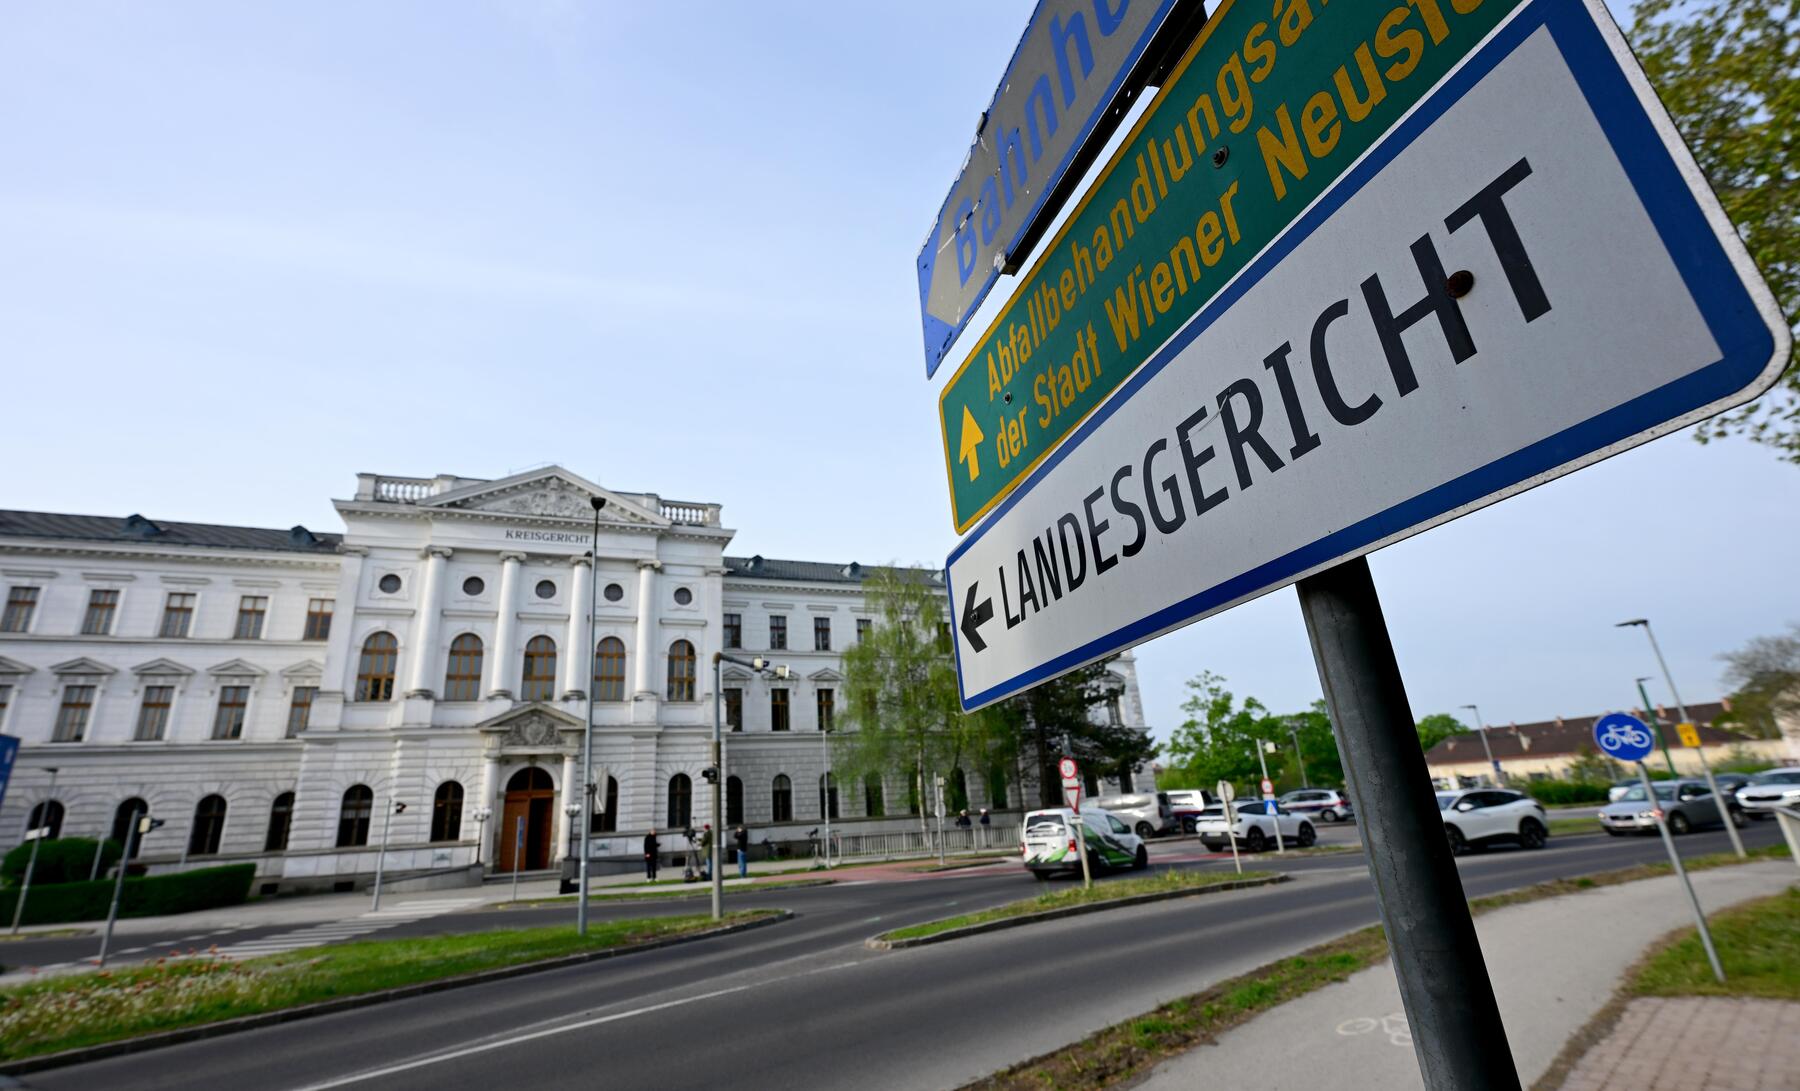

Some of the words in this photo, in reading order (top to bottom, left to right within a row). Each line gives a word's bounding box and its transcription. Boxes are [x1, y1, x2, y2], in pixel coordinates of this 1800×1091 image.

[987, 0, 1328, 402] Abfallbehandlungsa
[996, 405, 1028, 469] der
[1033, 323, 1102, 429] Stadt
[1104, 180, 1241, 353] Wiener
[1256, 0, 1484, 201] Neust
[998, 156, 1552, 630] LANDESGERICHT
